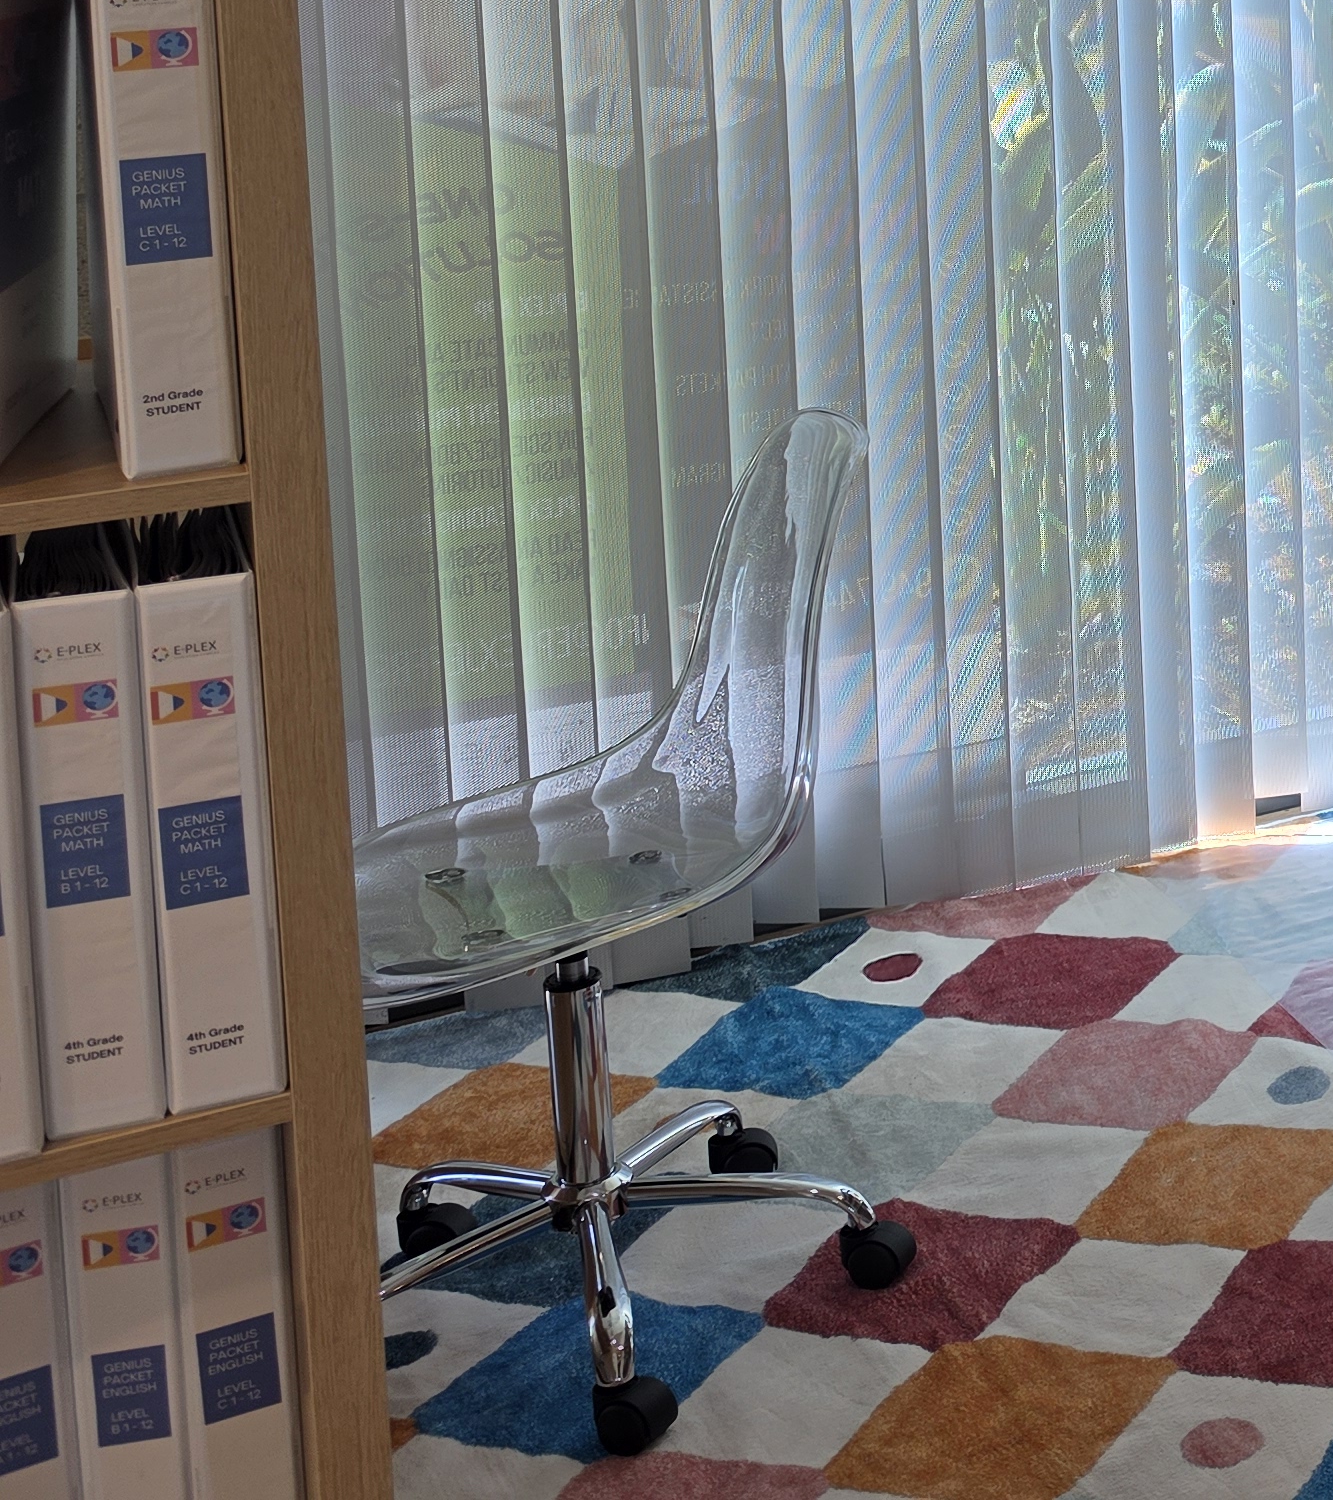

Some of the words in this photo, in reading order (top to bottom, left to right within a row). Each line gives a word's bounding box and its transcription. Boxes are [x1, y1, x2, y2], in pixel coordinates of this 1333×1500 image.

[132, 167, 185, 182] GENIUS
[132, 181, 187, 196] PACKET
[140, 196, 181, 209] MATH
[140, 223, 181, 238] LEVEL
[139, 241, 150, 252] C
[154, 239, 160, 250] 1
[173, 237, 187, 248] 12
[142, 394, 165, 404] 2nd
[167, 388, 204, 401] Grade
[145, 401, 202, 417] STUDENT
[57, 642, 101, 657] E-PLEX
[173, 640, 217, 656] E-PLEX
[54, 809, 108, 825] GENIUS
[172, 810, 225, 828] GENIUS
[54, 822, 110, 839] PACKET
[172, 823, 228, 842] PACKET
[61, 837, 104, 852] MATH
[180, 837, 222, 854] MATH
[61, 865, 104, 880] LEVEL
[180, 865, 222, 881] LEVEL
[61, 883, 71, 894] B
[75, 881, 81, 891] 1
[94, 877, 109, 888] 12
[180, 884, 190, 895] C
[195, 882, 201, 892] 1
[214, 877, 228, 889] 12
[186, 1031, 207, 1042] 4th
[208, 1024, 245, 1038] Grade
[65, 1041, 84, 1051] 4th
[87, 1034, 124, 1048] Grade
[189, 1035, 245, 1055] STUDENT
[66, 1046, 124, 1065] STUDENT
[204, 1168, 246, 1187] E-PLEX
[102, 1192, 143, 1207] E-PLEX
[209, 1328, 258, 1350] GENIUS
[209, 1340, 260, 1362] PACKET
[103, 1358, 152, 1375] GENIUS
[208, 1352, 263, 1376] ENGLISH
[103, 1371, 154, 1386] PACKET
[102, 1382, 157, 1399] ENGLISH
[217, 1380, 257, 1398] LEVEL
[111, 1408, 149, 1422] LEVEL
